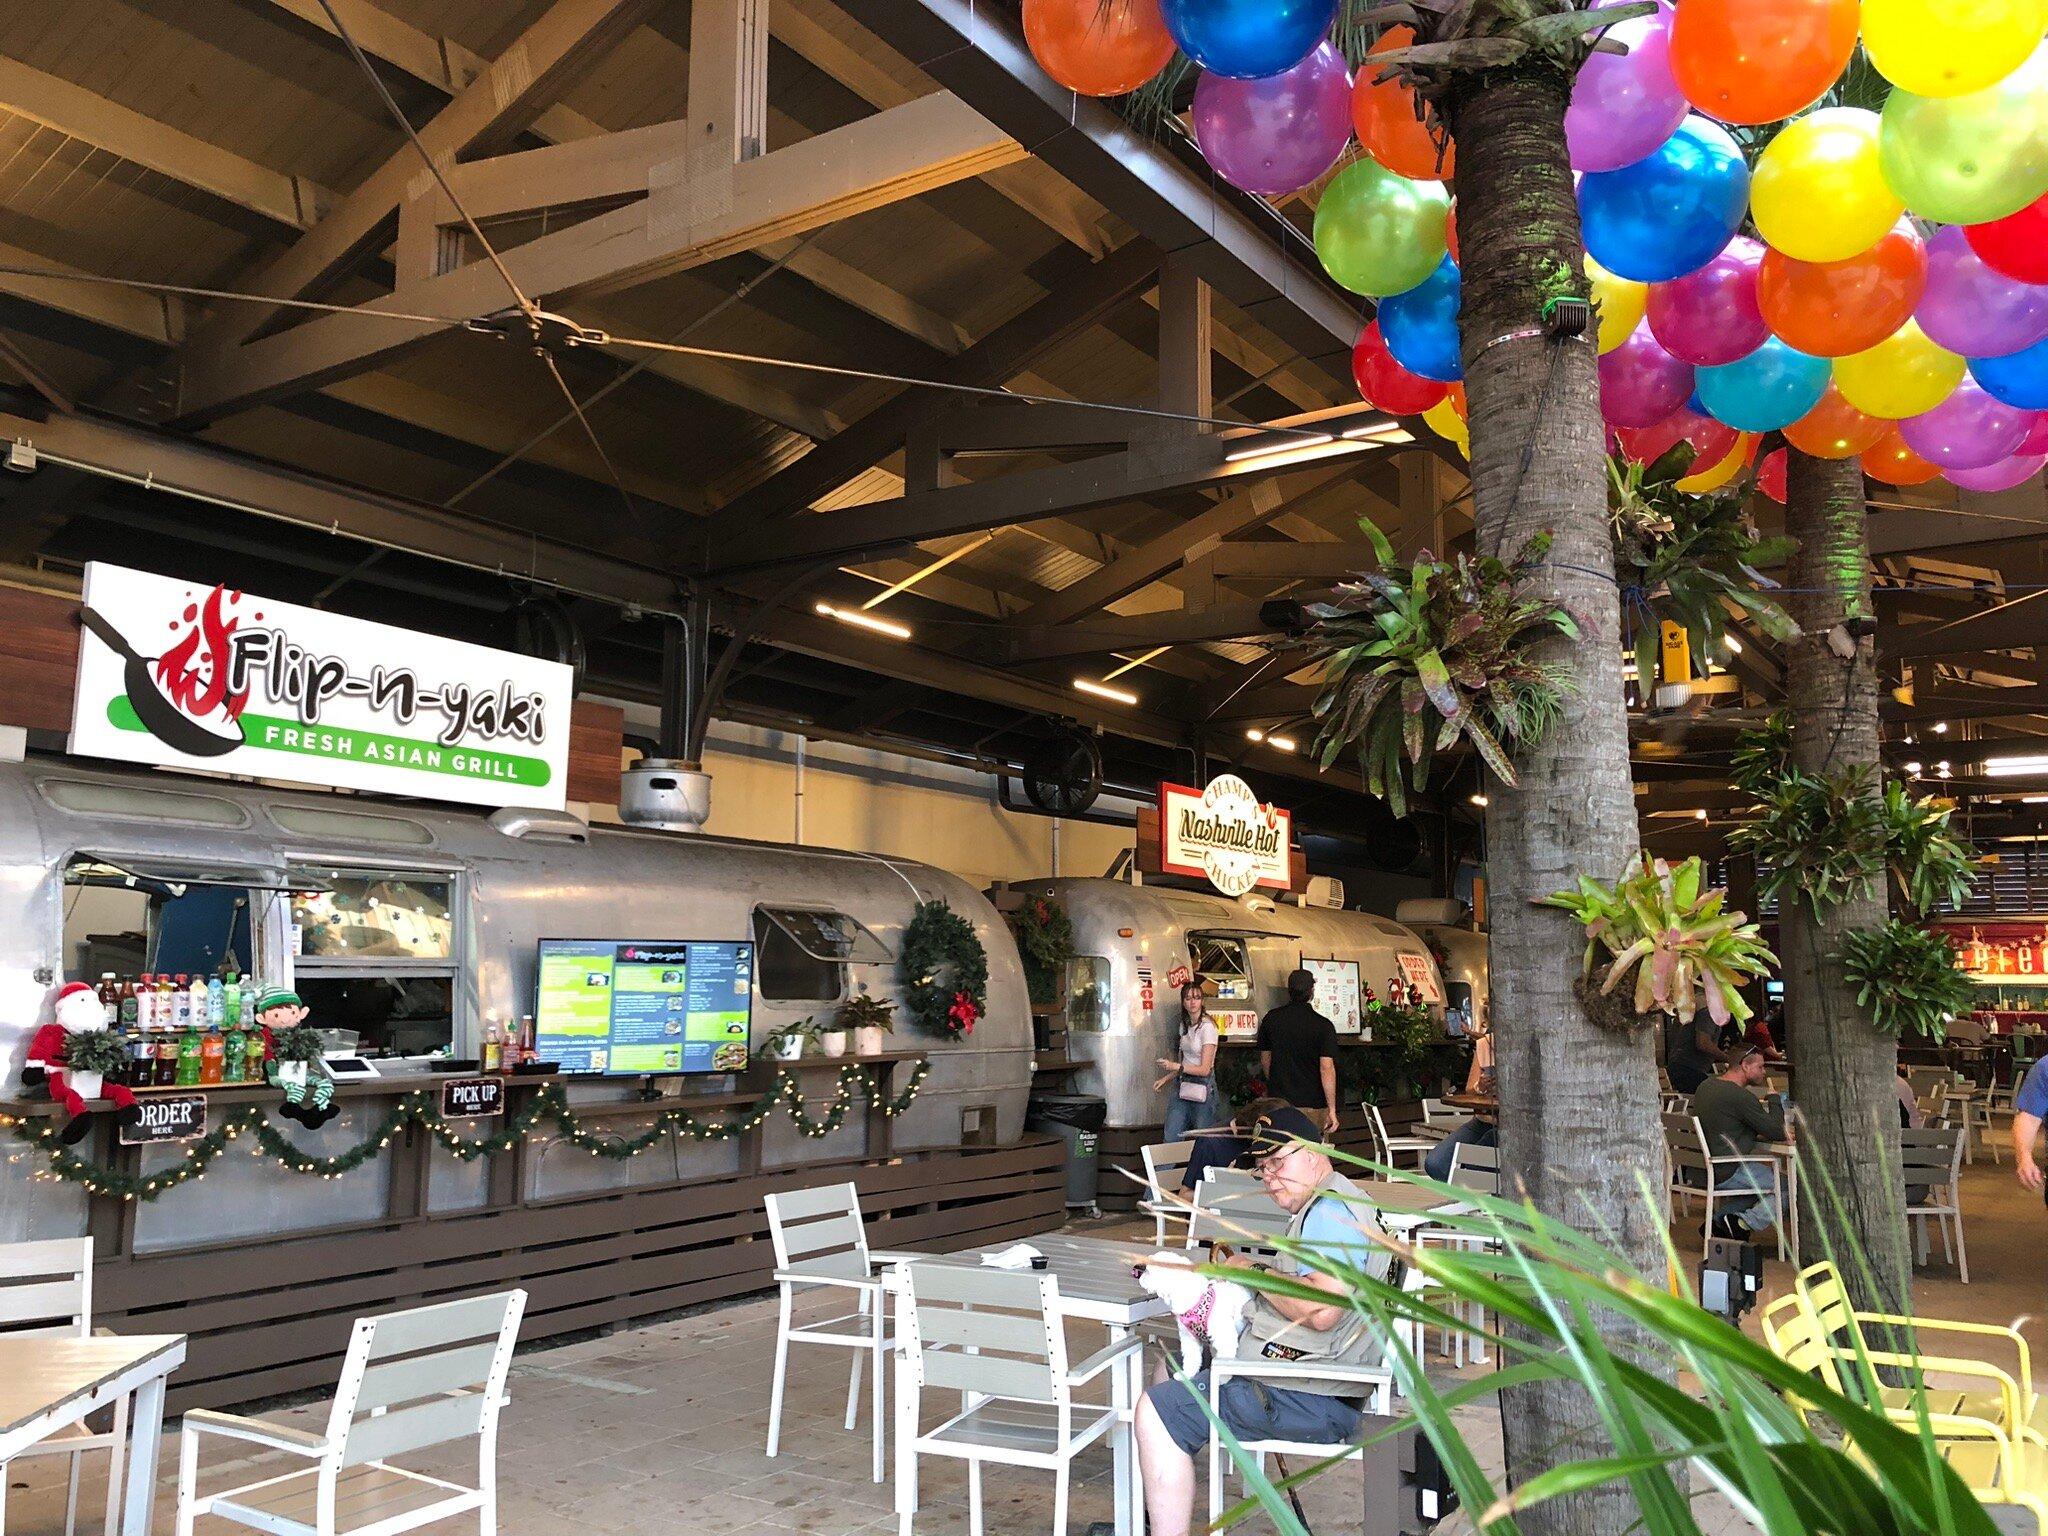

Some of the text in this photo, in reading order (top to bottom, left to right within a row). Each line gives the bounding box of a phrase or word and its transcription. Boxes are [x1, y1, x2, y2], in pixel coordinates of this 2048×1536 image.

[228, 628, 545, 746] Flip-n-yaki
[265, 725, 518, 779] FRESH ASIAN GRILL
[1180, 808, 1281, 854] Nashville Hot
[1170, 968, 1189, 985] OPEN
[1237, 1014, 1256, 1029] HERE
[452, 1084, 497, 1104] PICK UP
[152, 1125, 173, 1135] HERE
